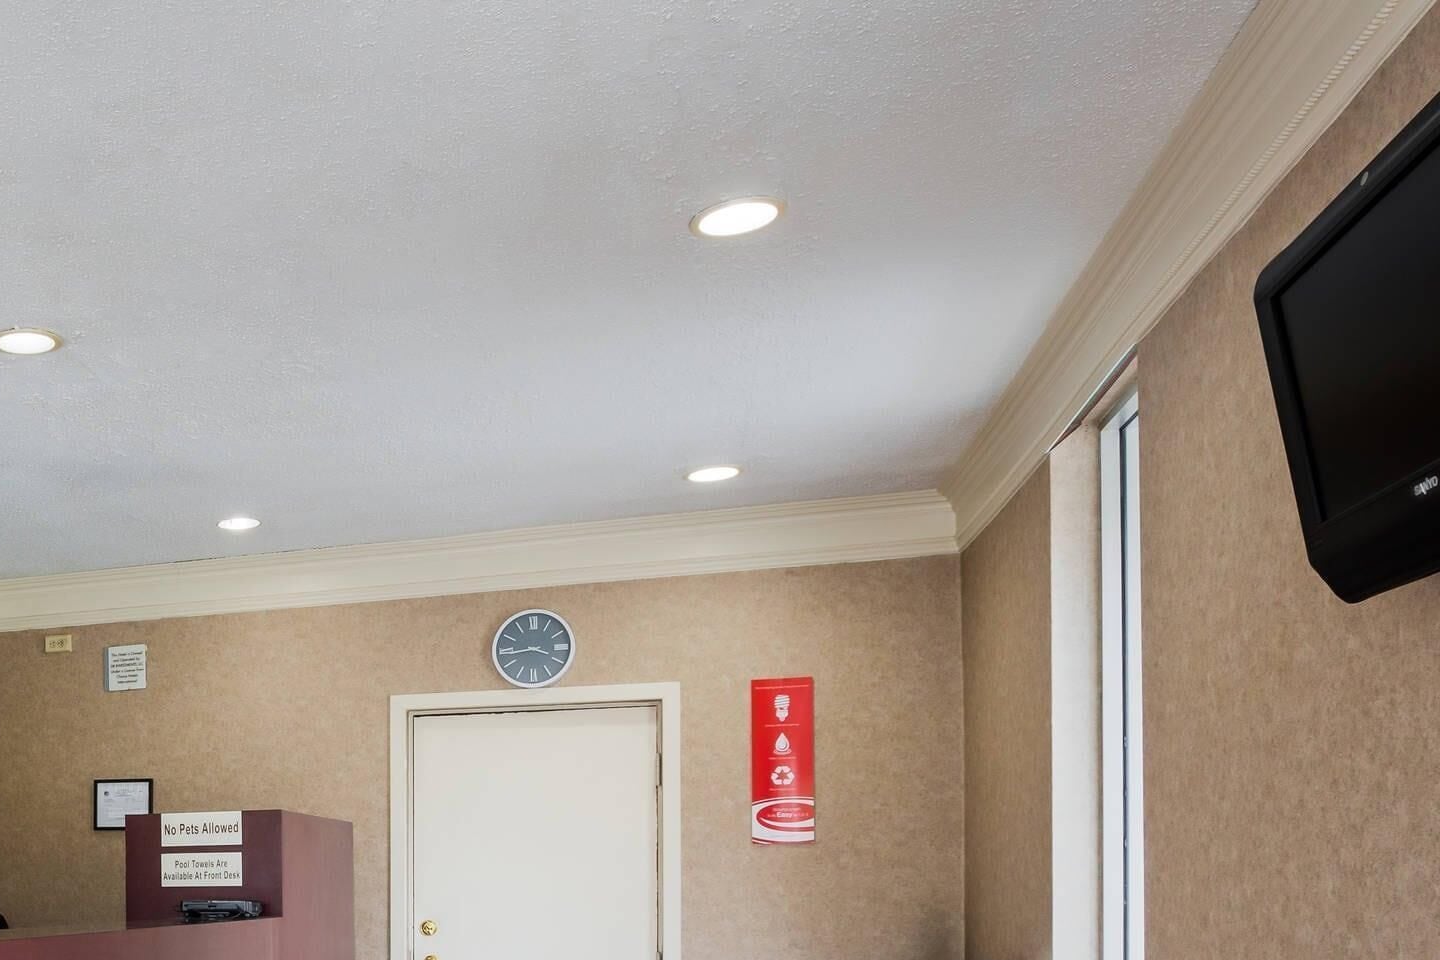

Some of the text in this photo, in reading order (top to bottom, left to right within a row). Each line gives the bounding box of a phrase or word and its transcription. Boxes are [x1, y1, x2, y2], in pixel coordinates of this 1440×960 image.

[1414, 475, 1438, 496] SANYO
[164, 821, 239, 836] No Pets Allowed
[174, 858, 228, 869] Pool Towels Are
[163, 870, 241, 881] Available At Front Desk
